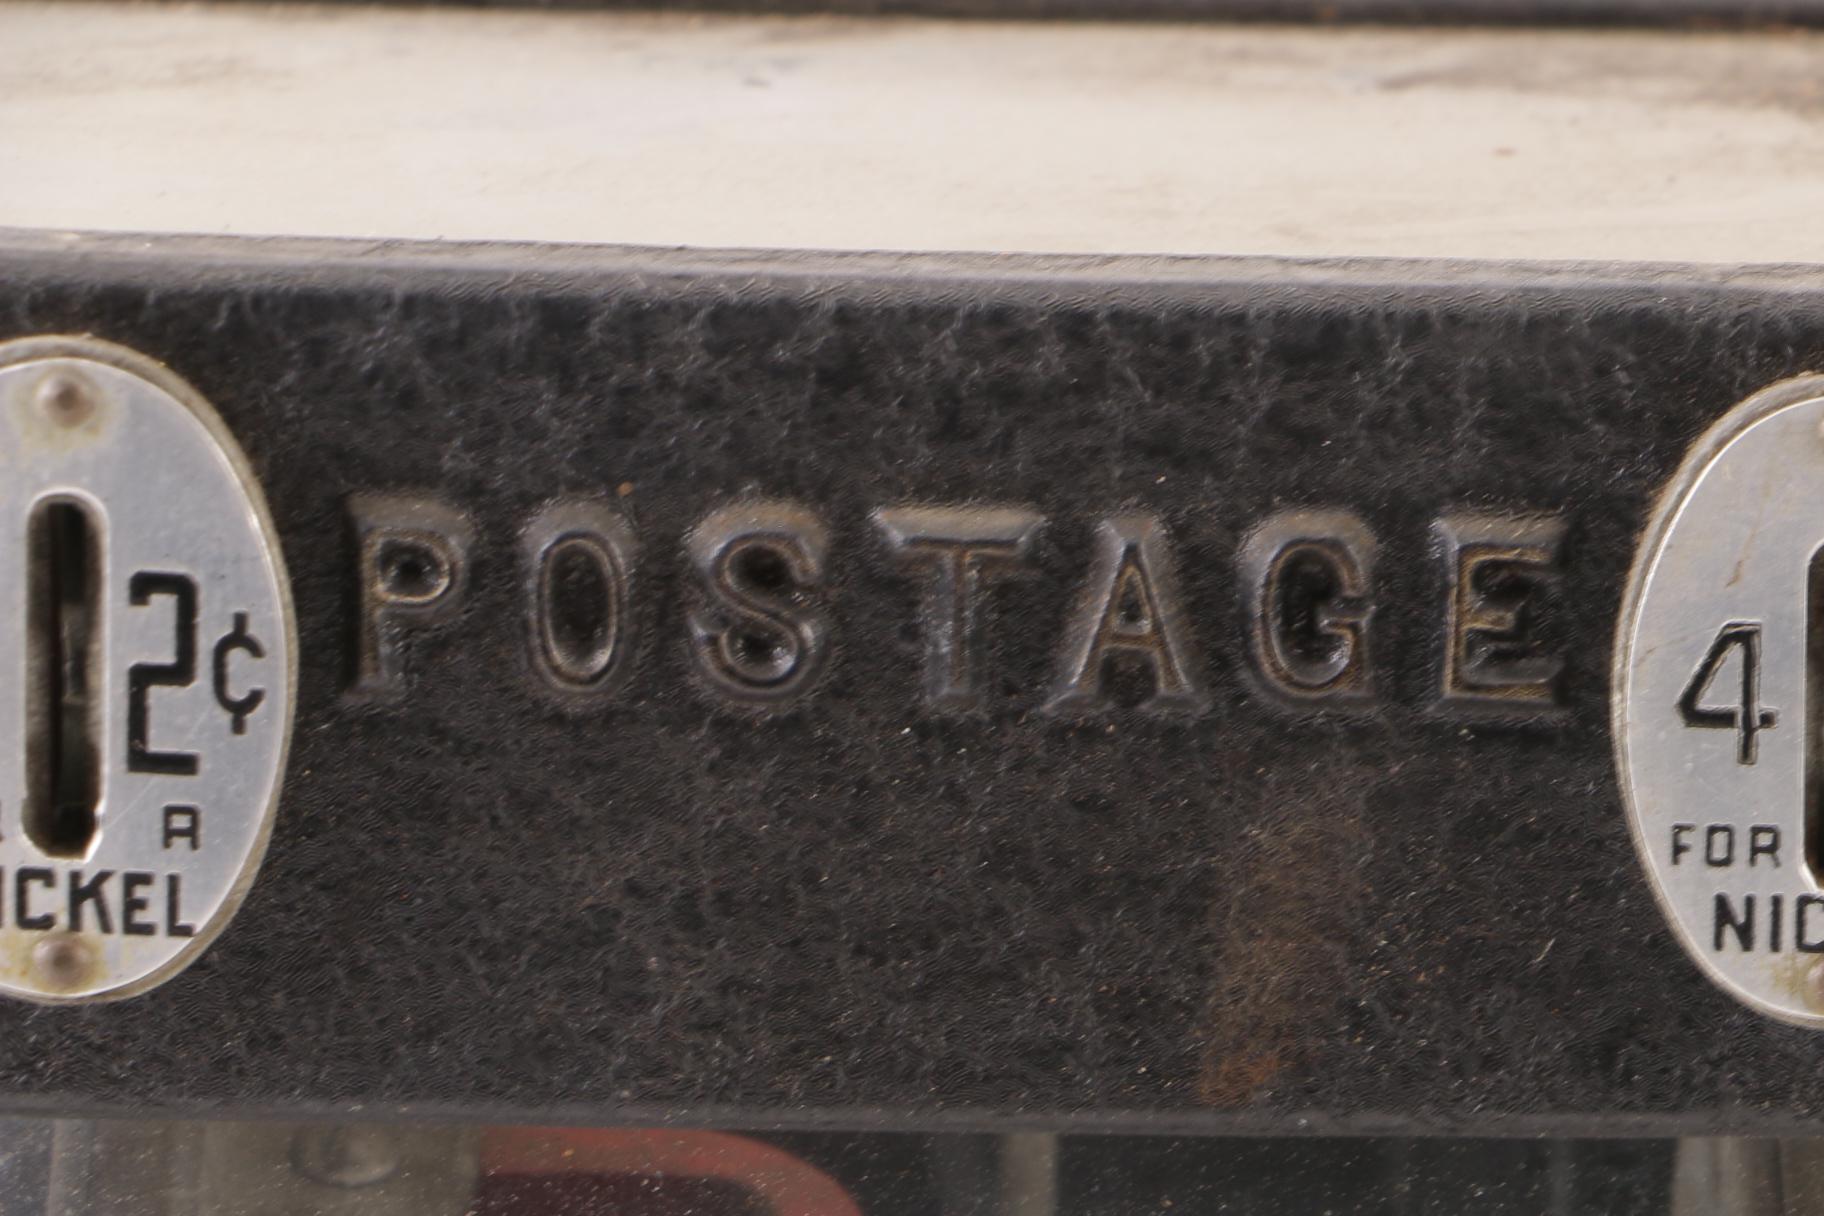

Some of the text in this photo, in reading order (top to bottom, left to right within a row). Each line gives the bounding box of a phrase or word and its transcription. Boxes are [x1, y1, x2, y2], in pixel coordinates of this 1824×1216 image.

[344, 494, 1570, 720] POSTAGE
[1675, 620, 1780, 766] 4
[162, 805, 201, 851] A
[1671, 823, 1782, 868] FOR
